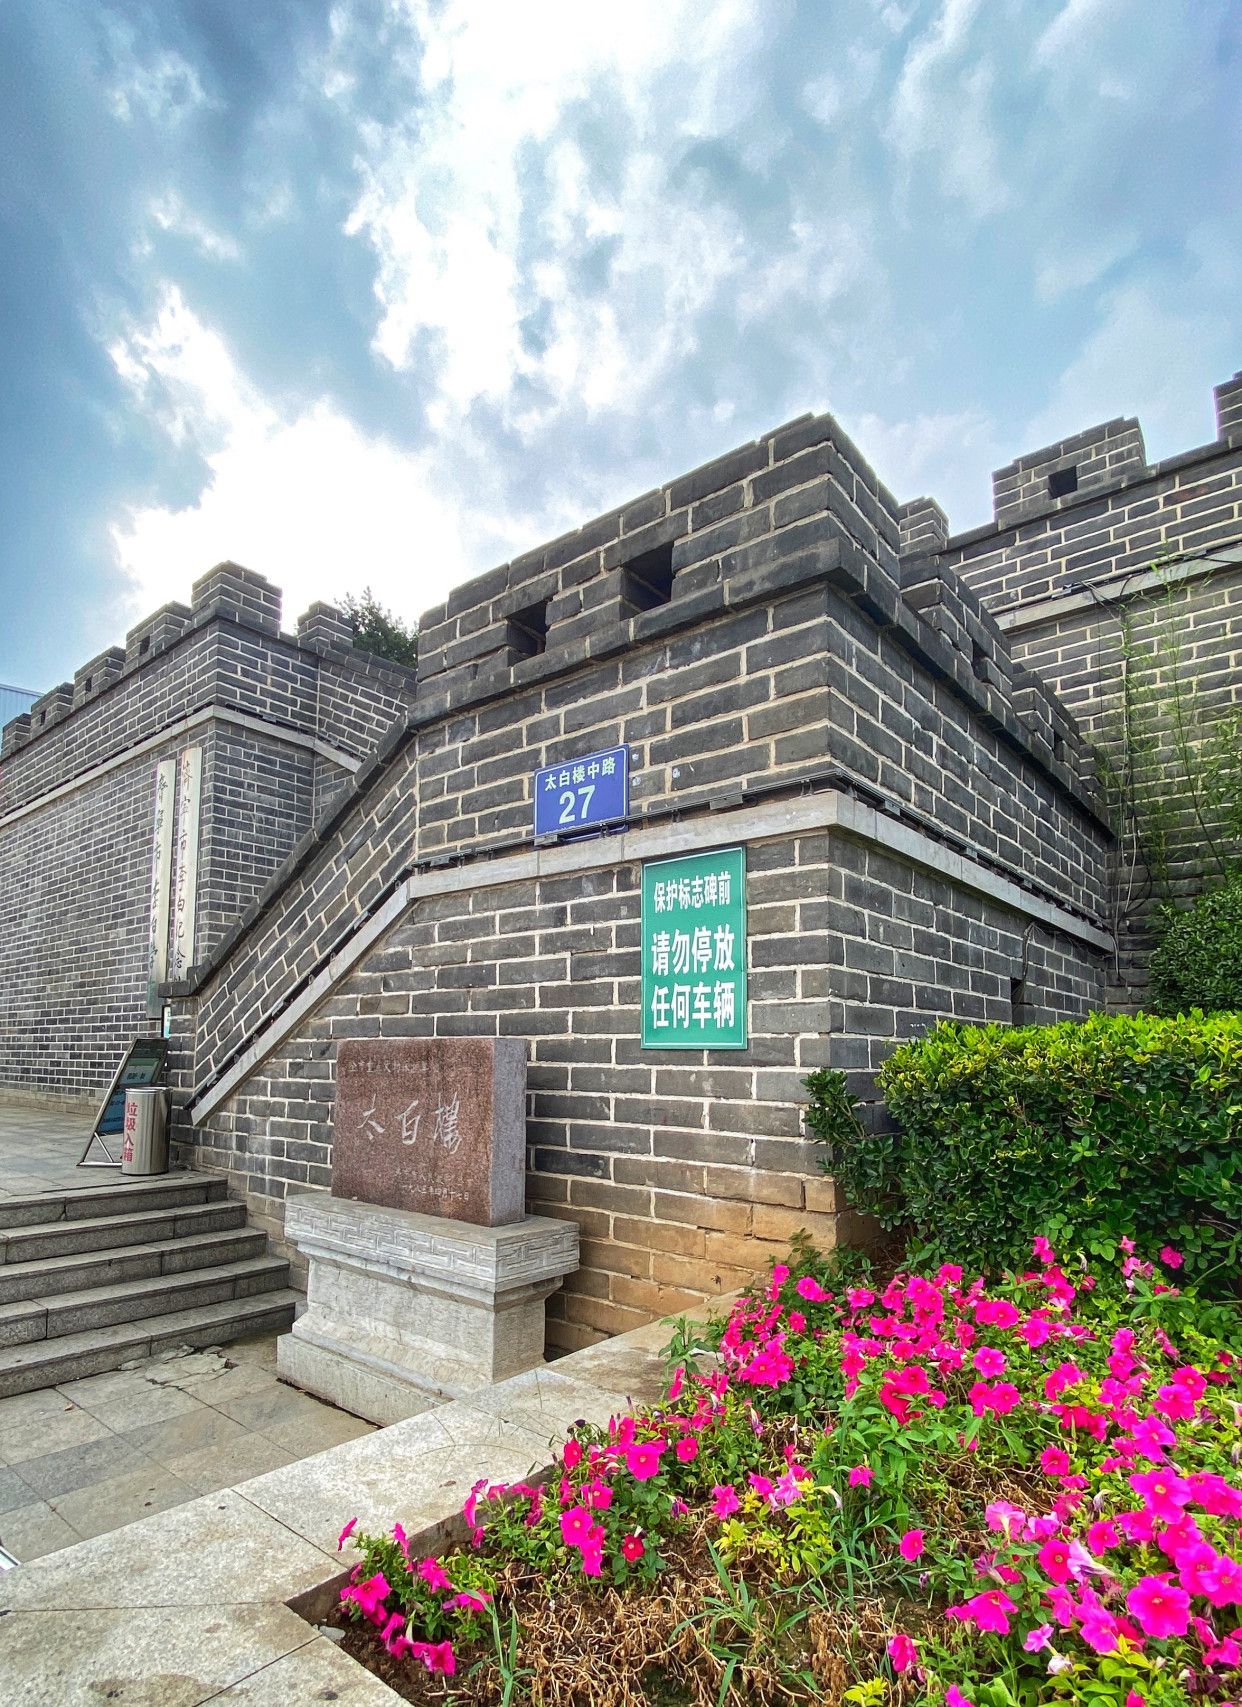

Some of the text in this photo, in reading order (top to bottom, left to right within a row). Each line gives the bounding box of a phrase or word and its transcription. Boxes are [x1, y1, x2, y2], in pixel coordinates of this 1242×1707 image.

[545, 757, 616, 792] 太白楼中路
[558, 784, 596, 825] 27
[653, 871, 732, 914] 保护标志碑前
[651, 923, 735, 976] 请勿停放
[651, 979, 735, 1030] 任何车辆
[123, 1102, 139, 1163] 垃圾入箱
